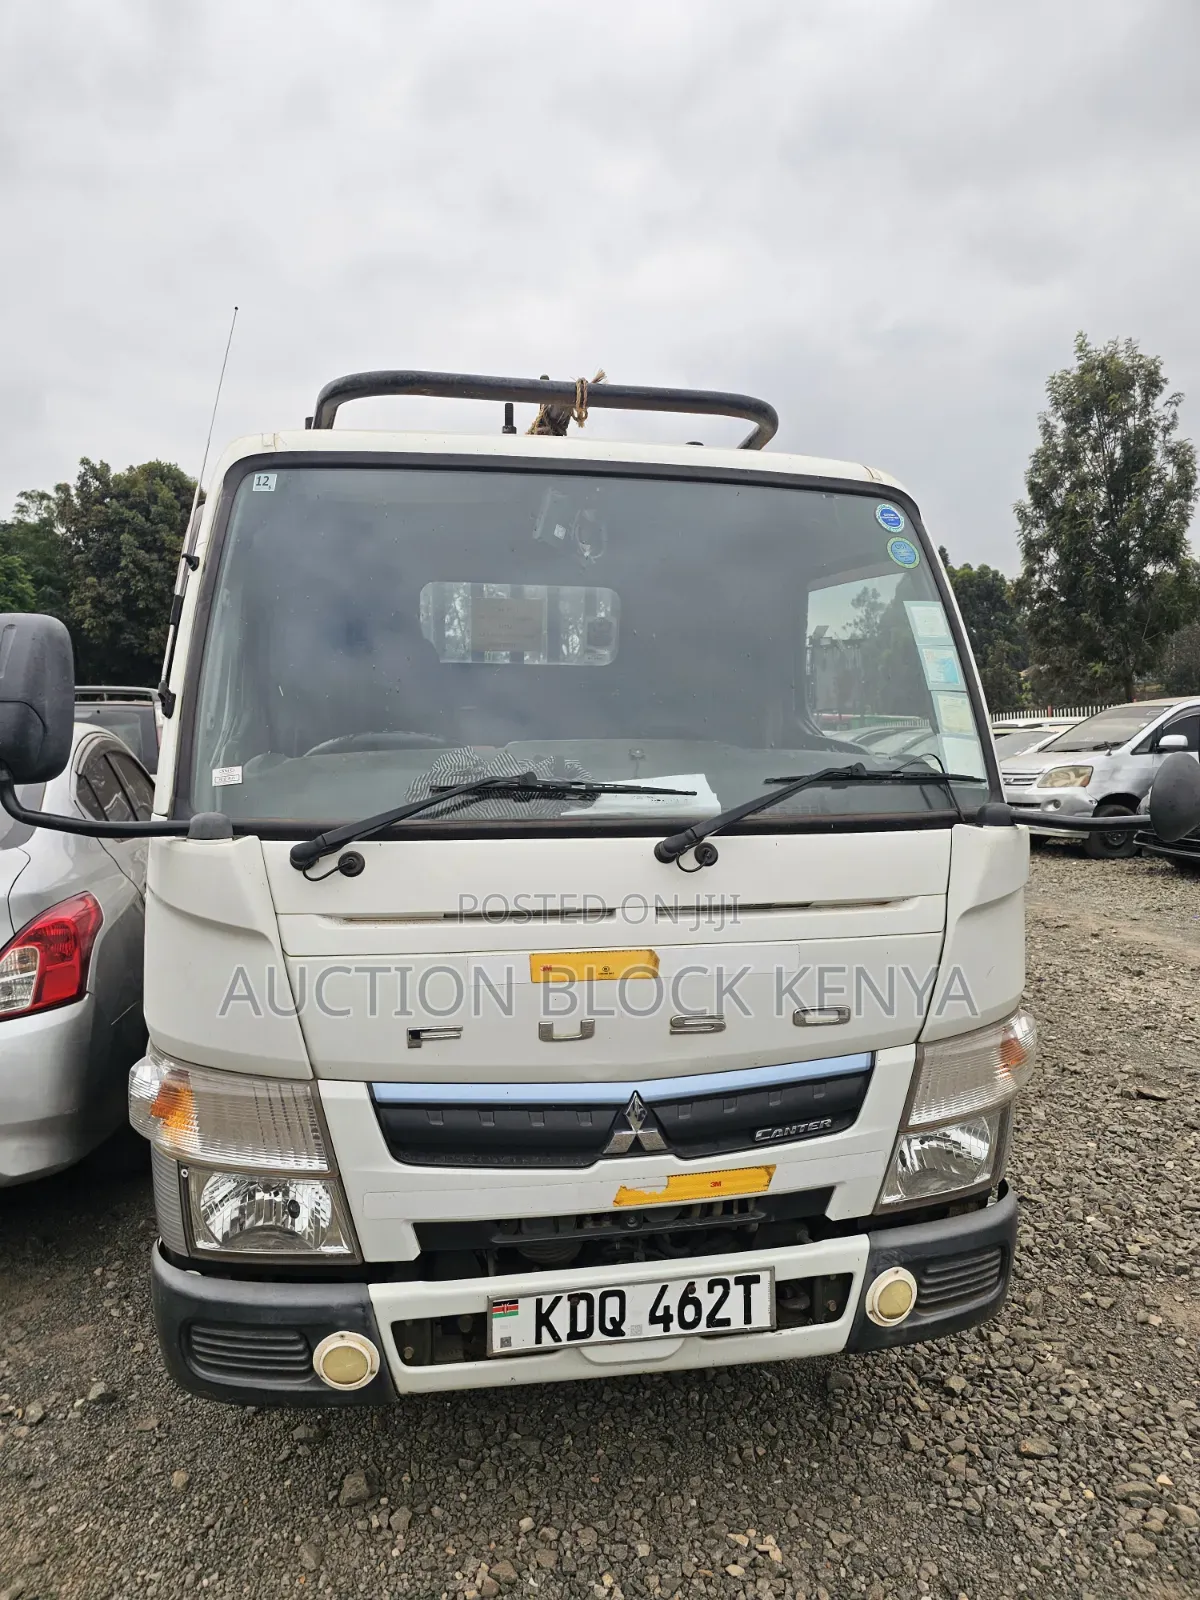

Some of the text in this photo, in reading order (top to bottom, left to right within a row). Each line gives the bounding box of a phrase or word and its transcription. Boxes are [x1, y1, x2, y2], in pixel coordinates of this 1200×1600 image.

[255, 475, 270, 486] 12
[407, 1004, 851, 1049] FUSO
[754, 1118, 832, 1141] CANTER
[710, 1180, 722, 1188] 3M
[534, 1274, 761, 1345] KDQ 462T
